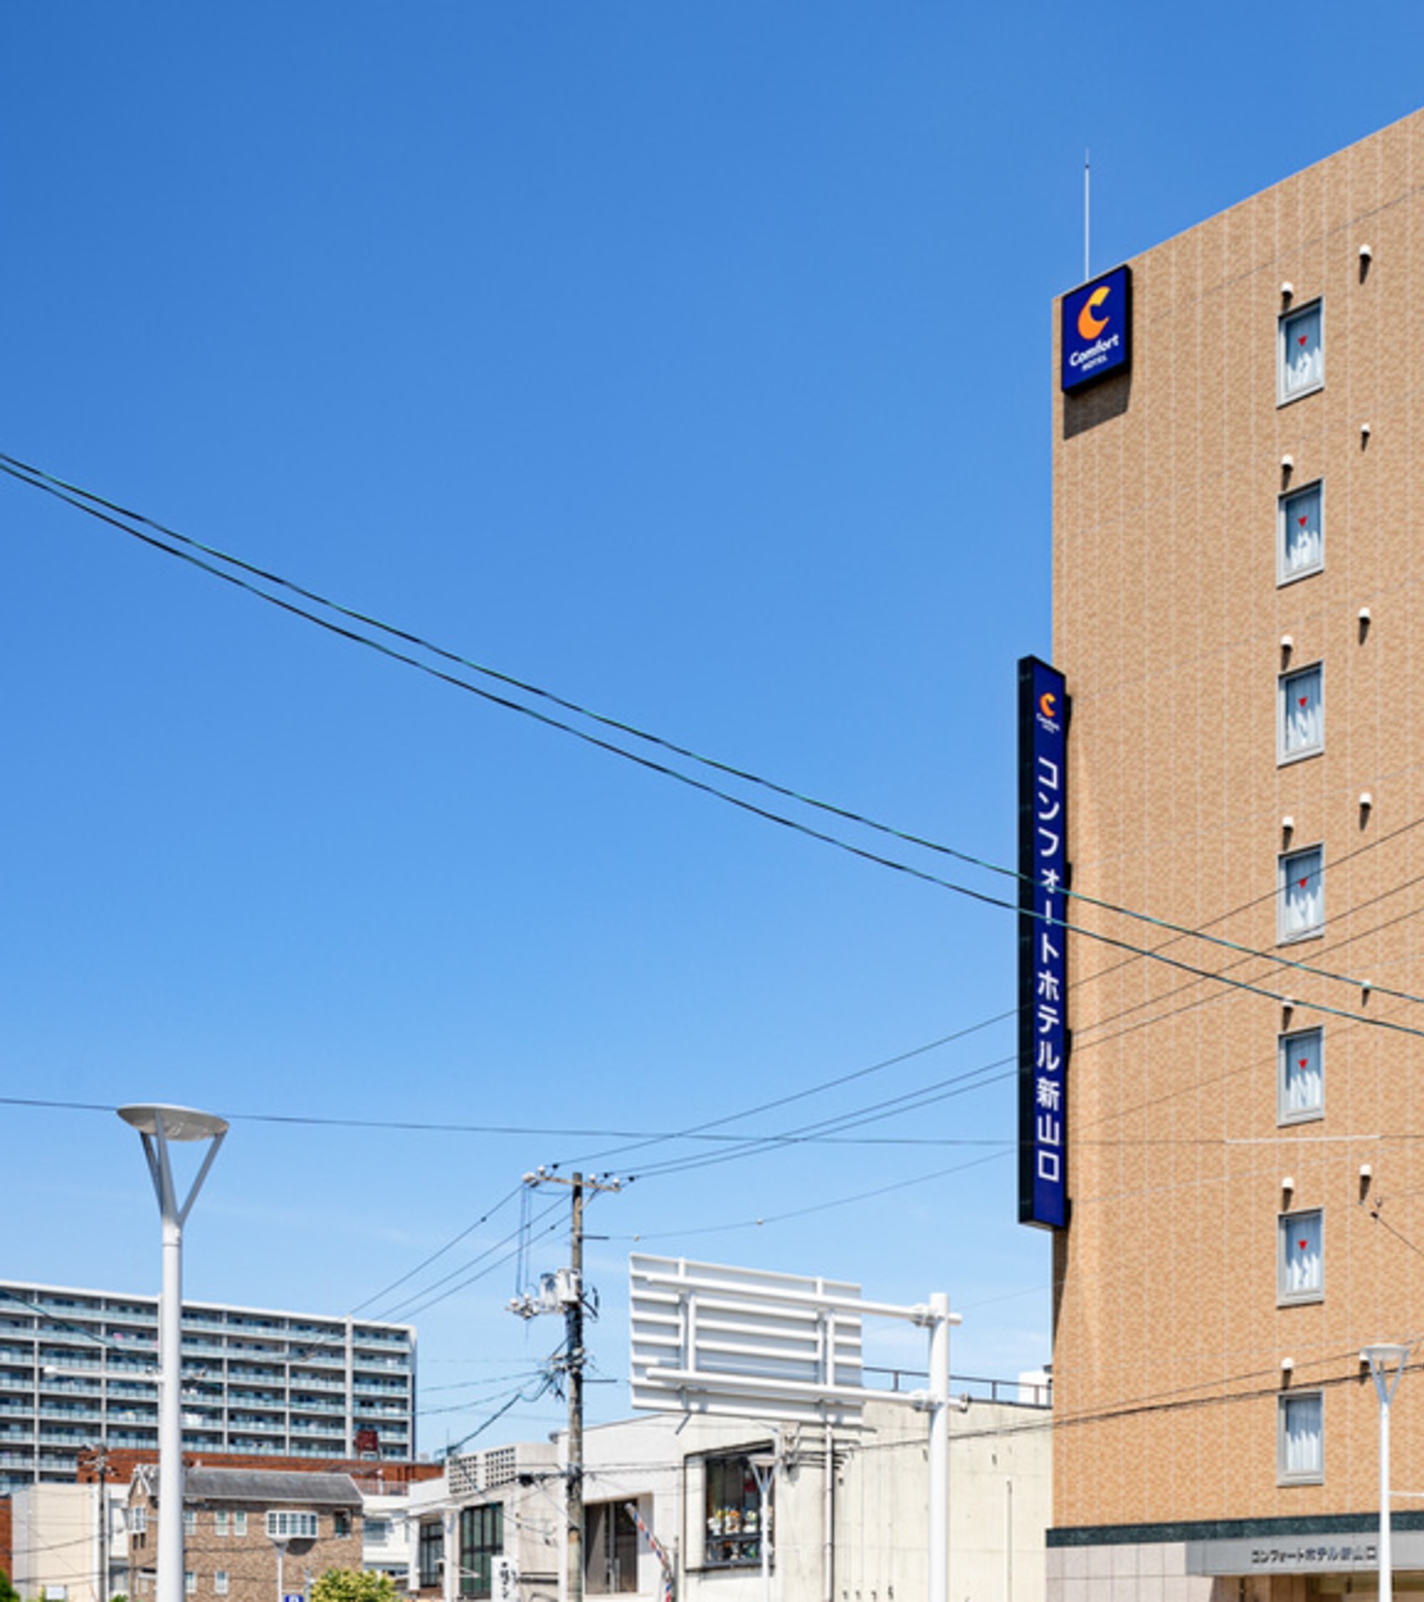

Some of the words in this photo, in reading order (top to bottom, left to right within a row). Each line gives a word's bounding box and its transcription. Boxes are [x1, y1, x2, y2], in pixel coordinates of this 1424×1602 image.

[1069, 334, 1119, 367] Comfort
[1038, 756, 1061, 1183] コンフォートホテル新山口
